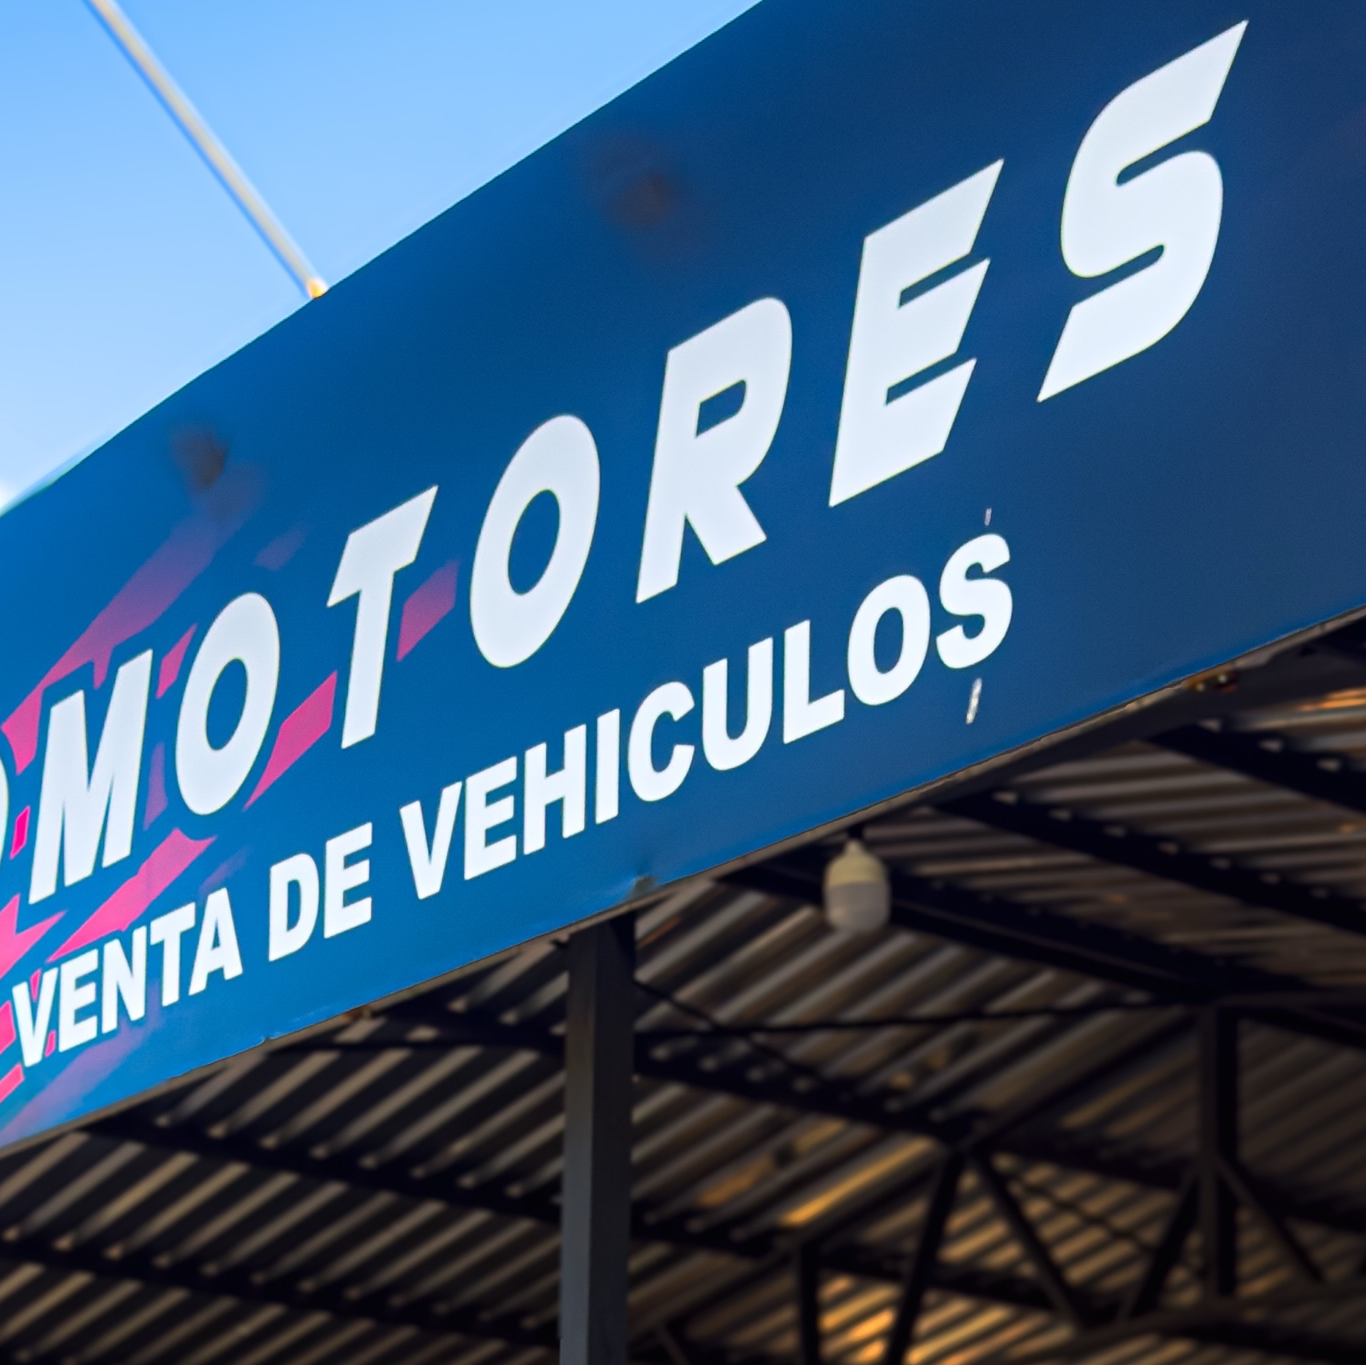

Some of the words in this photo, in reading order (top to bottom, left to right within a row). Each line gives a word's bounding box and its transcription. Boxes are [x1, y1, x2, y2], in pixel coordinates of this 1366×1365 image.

[11, 887, 244, 1068] VENTA
[267, 821, 373, 962] DE
[399, 533, 1013, 900] VEHICULOS
